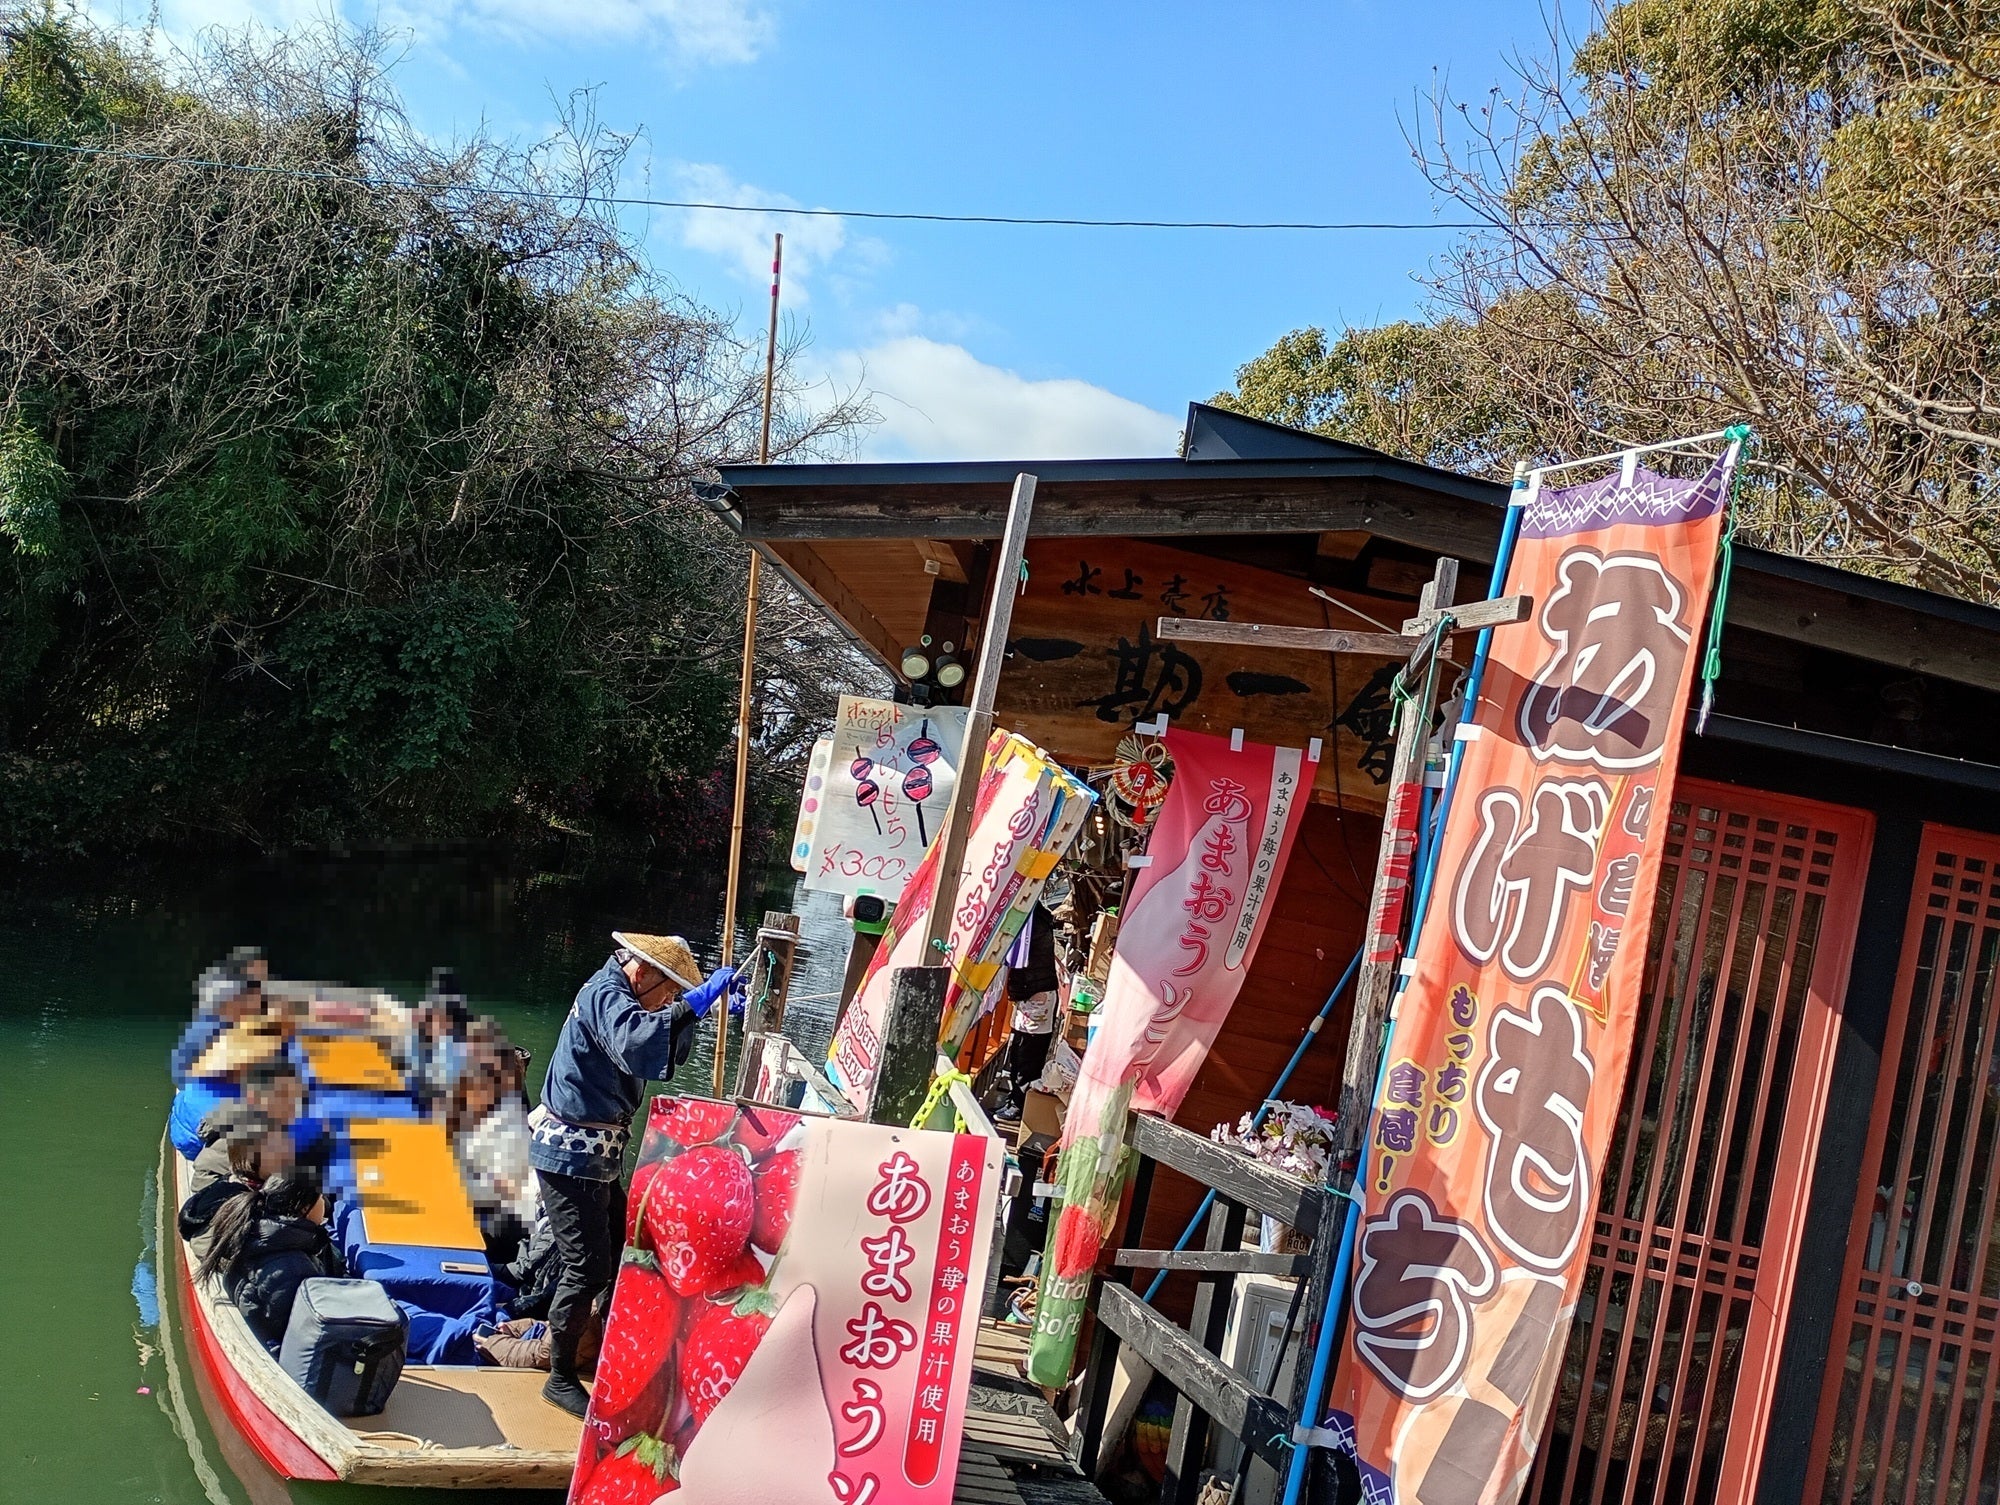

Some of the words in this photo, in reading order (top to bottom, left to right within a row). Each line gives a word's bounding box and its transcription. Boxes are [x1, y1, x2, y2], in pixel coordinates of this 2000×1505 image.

[876, 718, 907, 848] あげもち
[1232, 771, 1294, 950] あまおう苺の果汁使用
[1353, 546, 1692, 1404] あげもち
[1429, 984, 1481, 1145] もっちり
[913, 1160, 976, 1445] あまおう苺の果汁使用
[1044, 1274, 1090, 1300] Stra
